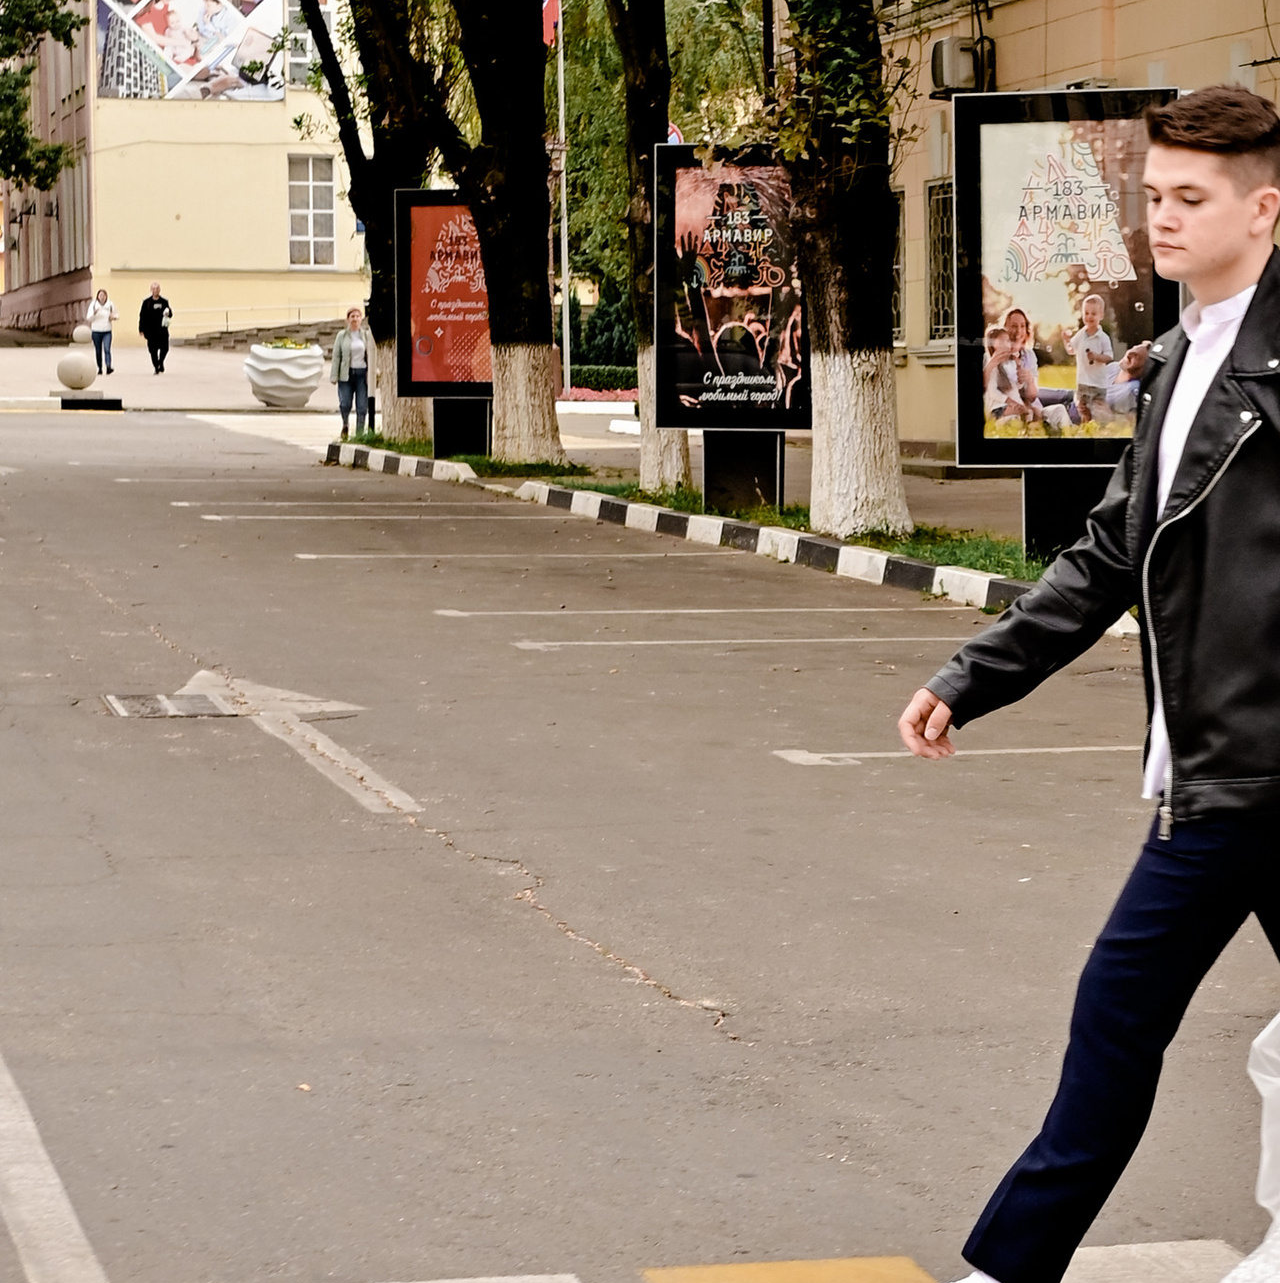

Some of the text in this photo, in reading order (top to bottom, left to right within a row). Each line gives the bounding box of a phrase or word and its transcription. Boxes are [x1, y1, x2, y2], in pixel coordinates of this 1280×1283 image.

[1052, 180, 1085, 197] 183
[727, 211, 750, 225] 183
[1018, 203, 1117, 222] АРМАВИР
[702, 229, 773, 244] АРМАВИР
[430, 250, 480, 262] АРМАВИ
